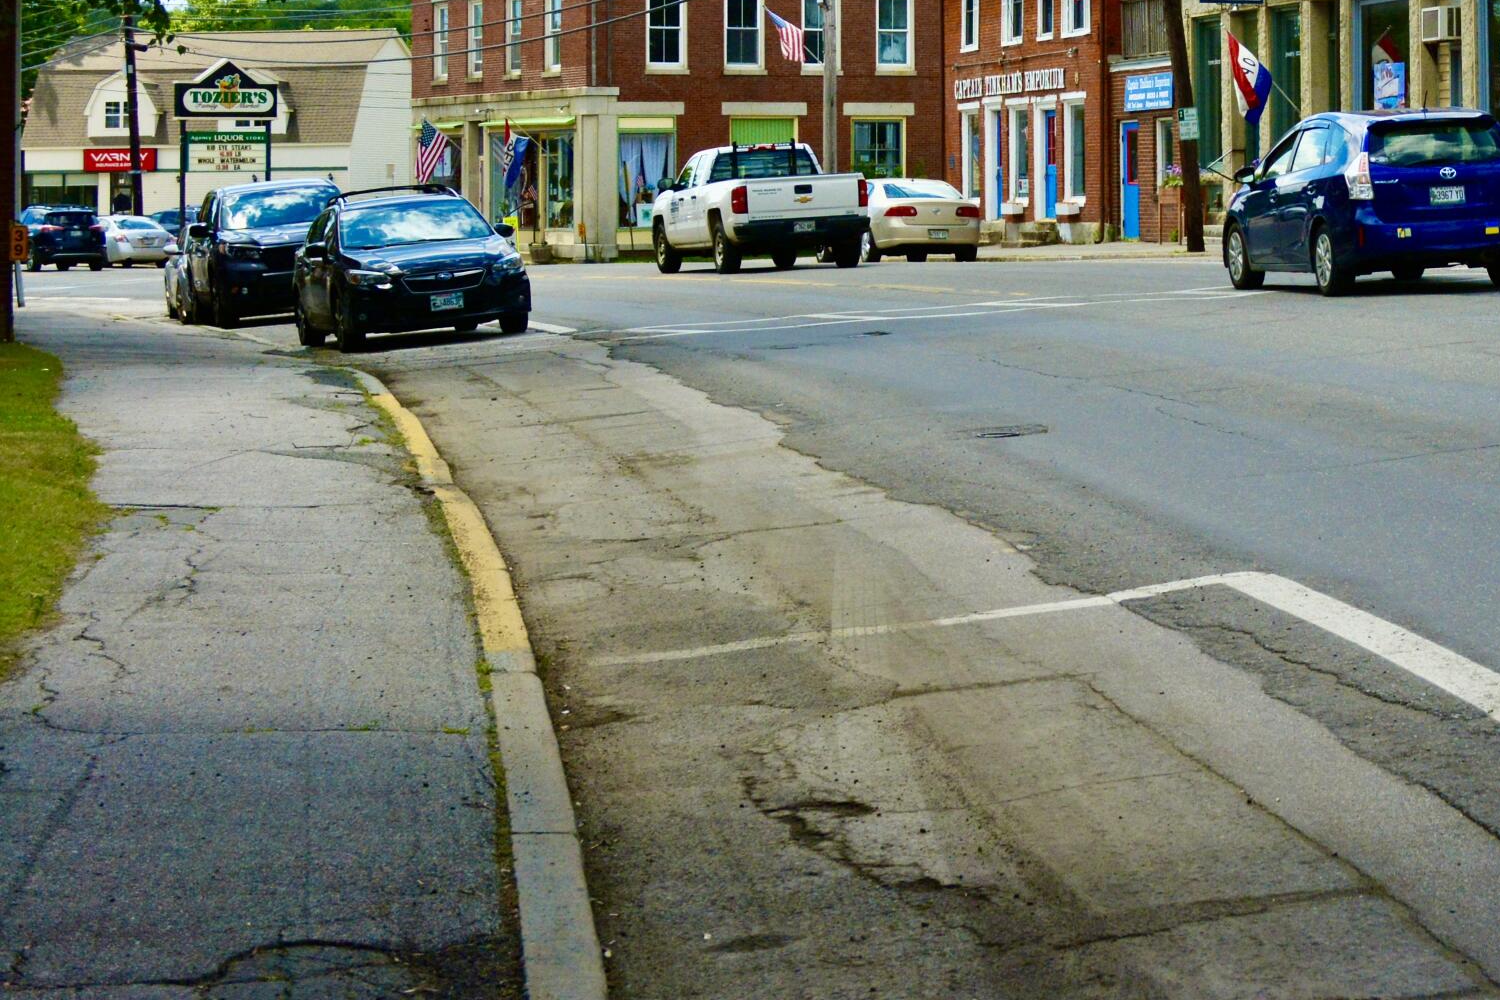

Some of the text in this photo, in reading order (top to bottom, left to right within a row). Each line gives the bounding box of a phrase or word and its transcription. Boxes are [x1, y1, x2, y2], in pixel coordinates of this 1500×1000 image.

[954, 68, 1065, 99] CAPTAIN TINKHAM'S EMPORIUM
[189, 91, 268, 104] TOZIER'S
[213, 134, 245, 142] LIQUOR
[90, 153, 149, 161] VARNY
[1436, 190, 1453, 200] 3967
